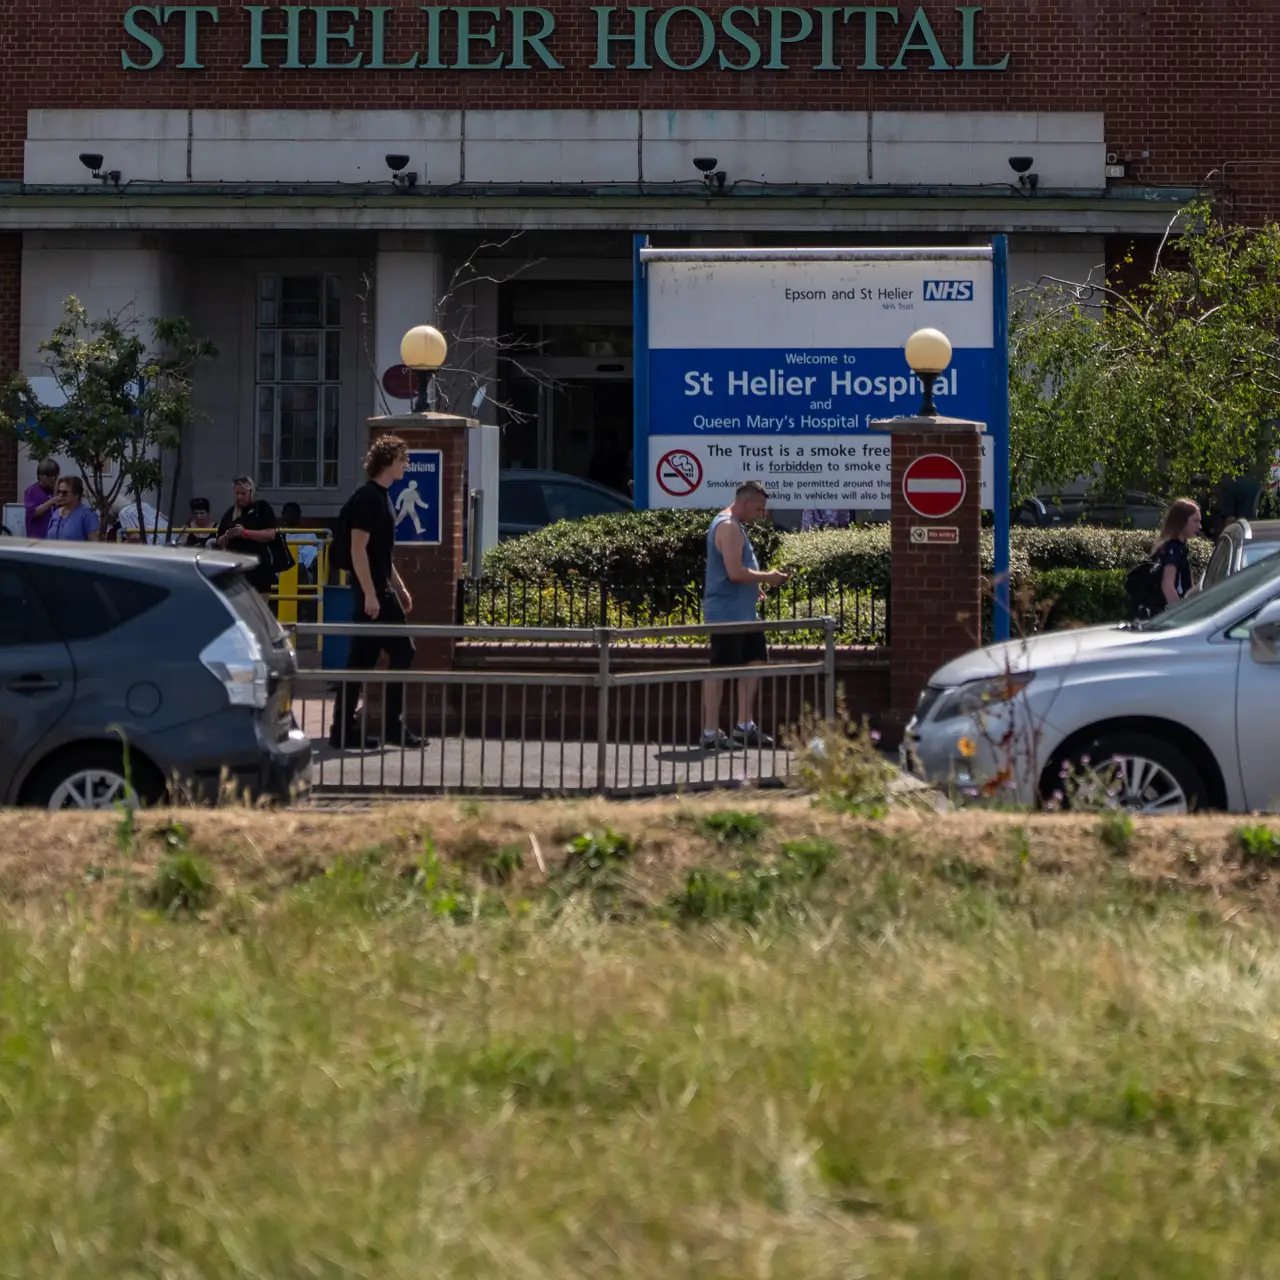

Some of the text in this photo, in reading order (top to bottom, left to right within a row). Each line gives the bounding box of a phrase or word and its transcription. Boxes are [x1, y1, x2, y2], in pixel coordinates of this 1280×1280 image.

[120, 4, 1011, 72] ST HELIER HOSPITAL
[784, 288, 914, 302] Epsom and St Helier
[924, 281, 973, 301] NHS
[785, 353, 856, 365] Welcome to
[684, 370, 714, 396] St
[728, 369, 817, 396] Helier
[809, 397, 832, 410] and
[693, 415, 741, 430] Queen
[746, 414, 795, 431] Mary's
[800, 414, 859, 431] Hospital
[707, 444, 891, 457] The Trust is a smoke free
[742, 462, 751, 472] It
[756, 461, 764, 472] is
[768, 461, 823, 473] forbidden
[827, 462, 840, 472] to
[845, 461, 881, 472] smoke
[765, 480, 780, 489] not
[782, 480, 793, 489] be
[797, 480, 840, 491] permitted
[842, 480, 874, 489] around
[876, 480, 891, 489] the
[793, 492, 802, 500] in
[805, 491, 838, 500] vehicles
[841, 491, 857, 500] will
[860, 491, 878, 500] also
